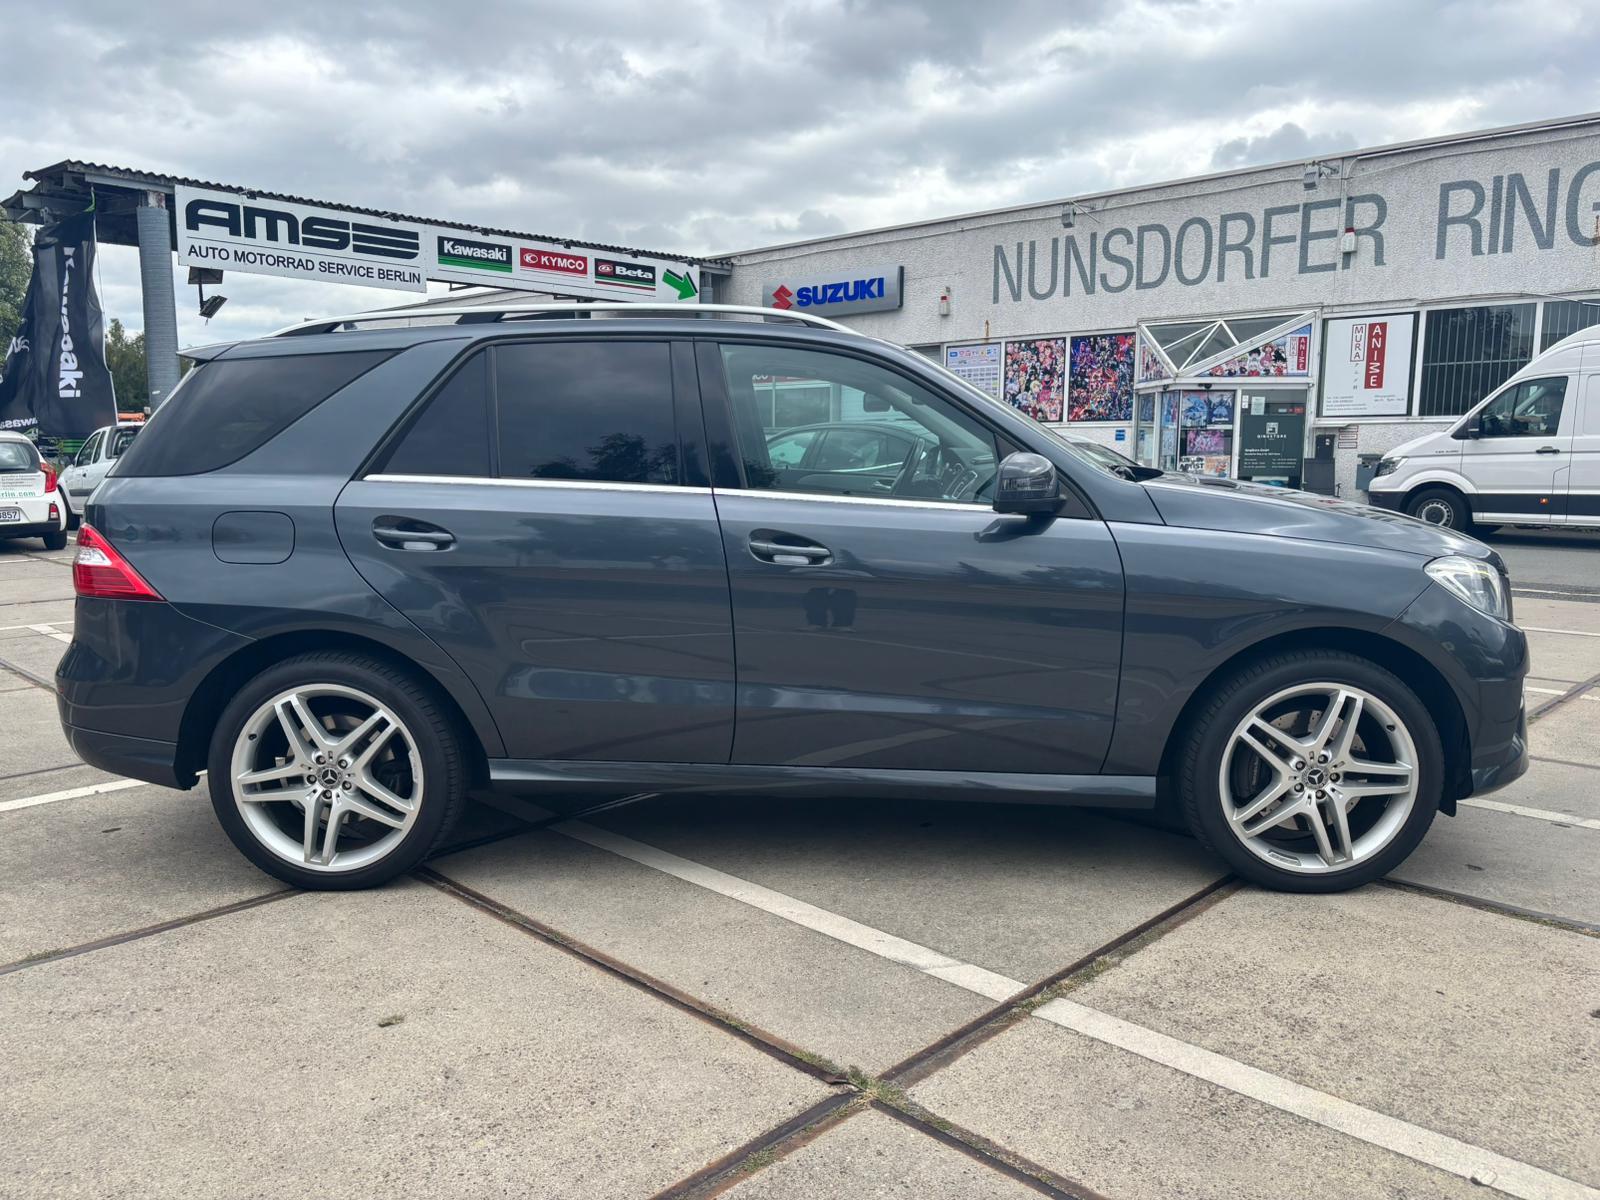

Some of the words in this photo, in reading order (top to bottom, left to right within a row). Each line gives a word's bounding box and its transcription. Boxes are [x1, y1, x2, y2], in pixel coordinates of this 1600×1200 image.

[992, 193, 1388, 305] NUNSDORFER
[1435, 161, 1600, 261] RING
[187, 244, 230, 261] AUTO
[233, 251, 315, 271] MOTORRAD
[318, 262, 375, 279] SERVICE
[378, 268, 421, 285] BERLIN
[443, 240, 507, 262] Kawasaki
[541, 255, 585, 271] KYMCO
[615, 265, 653, 280] Beta
[796, 277, 884, 307] SUZUKI
[1354, 326, 1364, 360] MURA
